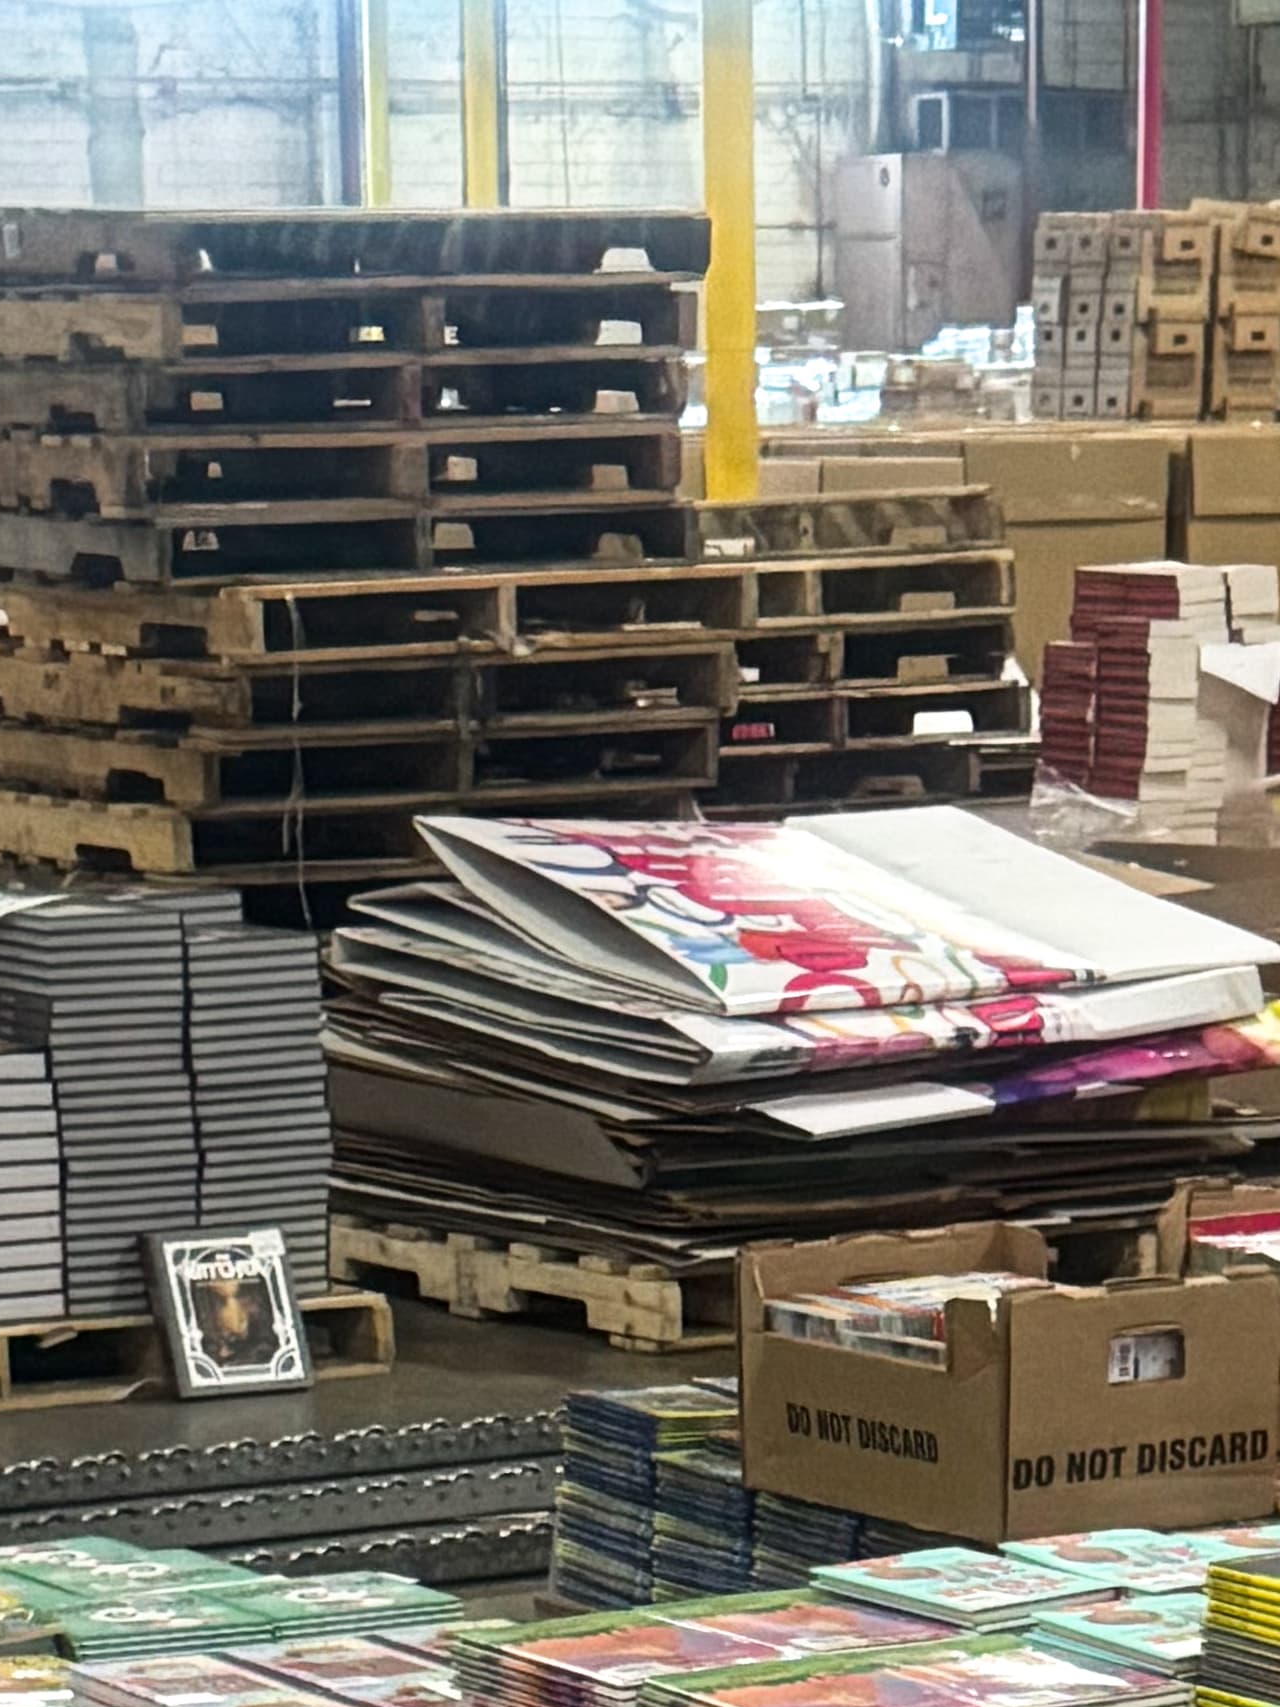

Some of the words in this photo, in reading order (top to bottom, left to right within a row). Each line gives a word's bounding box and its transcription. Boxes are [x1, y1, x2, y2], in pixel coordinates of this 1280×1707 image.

[786, 1402, 812, 1437] DO
[818, 1409, 852, 1445] NOT
[857, 1415, 939, 1464] DISCARD
[1013, 1455, 1055, 1491] DO
[1066, 1447, 1128, 1484] NOT
[1136, 1429, 1269, 1475] DISCARD
